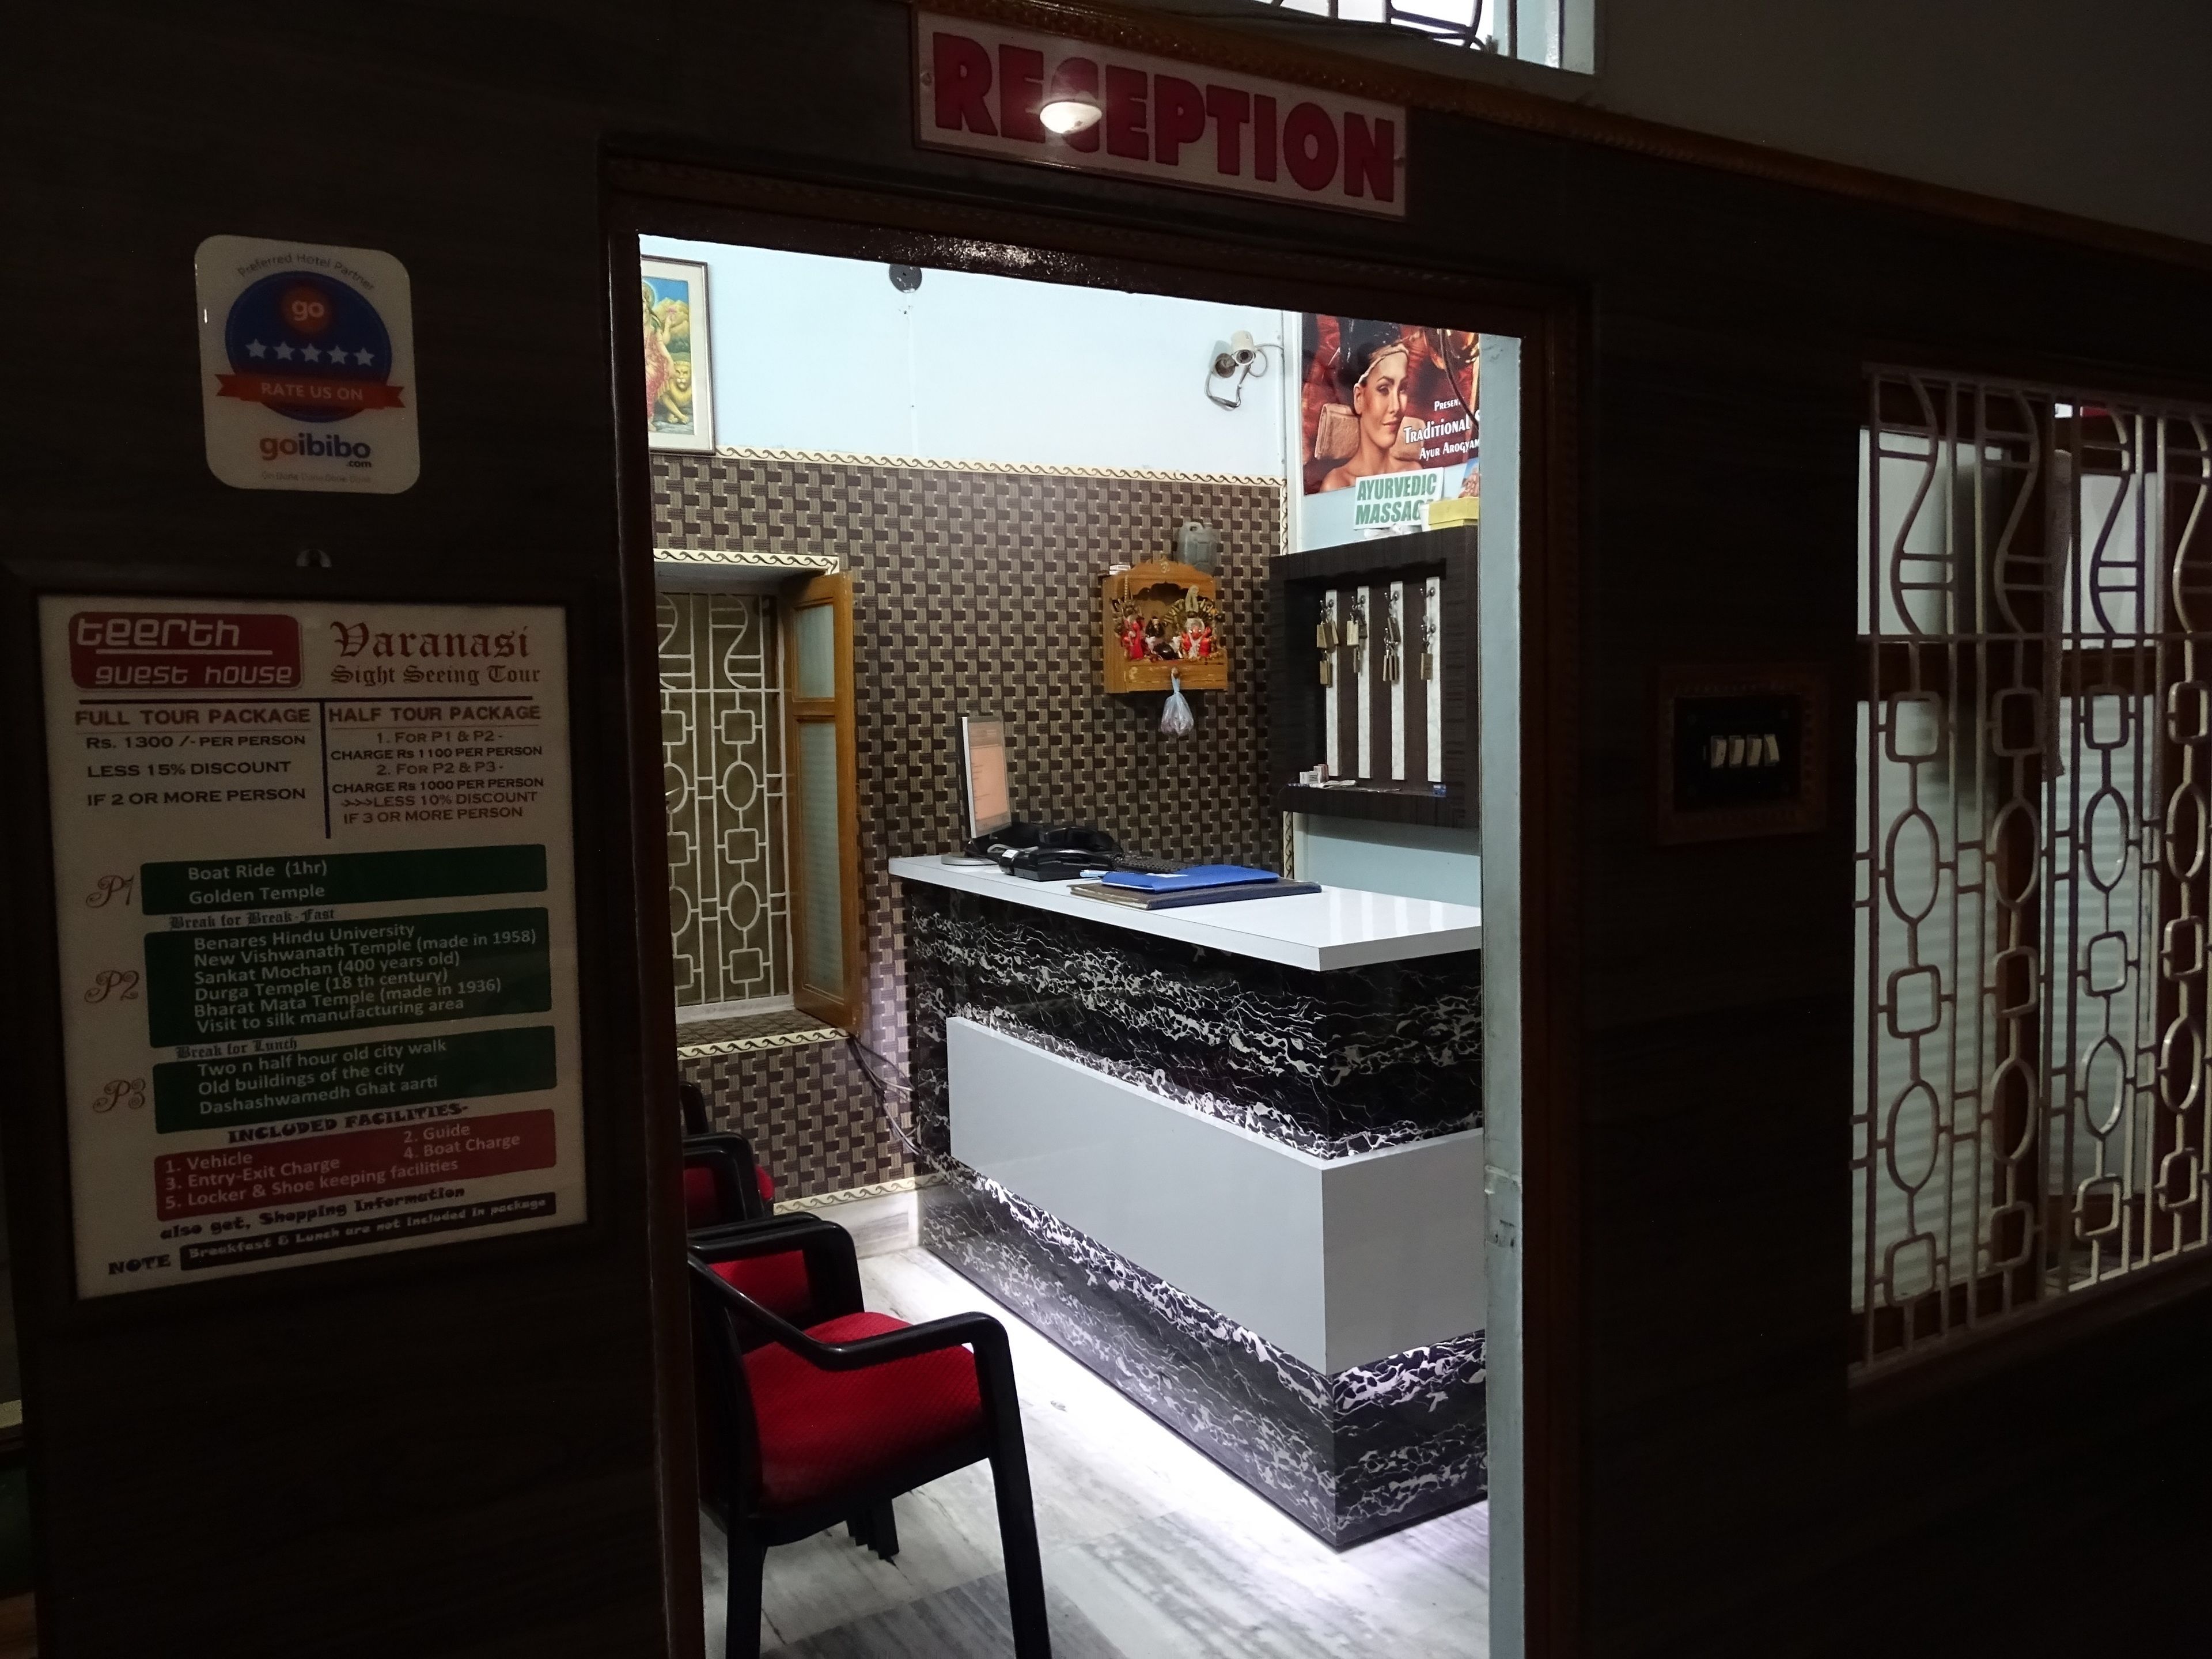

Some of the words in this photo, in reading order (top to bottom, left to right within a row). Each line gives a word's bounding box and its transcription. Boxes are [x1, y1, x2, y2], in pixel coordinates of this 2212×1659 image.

[932, 32, 1395, 203] RECEPTION
[237, 254, 293, 278] Preferred
[297, 253, 331, 269] Hotel
[334, 262, 375, 291] Partner
[291, 300, 325, 321] go
[261, 382, 305, 398] RATE
[310, 385, 332, 399] US
[336, 388, 363, 401] ON
[259, 433, 372, 460] goibibo
[1419, 446, 1440, 461] AYUR
[346, 460, 372, 468] .com
[1357, 473, 1437, 502] AYURVEDIC
[1355, 499, 1434, 525] MASSAG
[76, 618, 240, 647] teerth
[329, 621, 529, 658] Varanasi
[94, 665, 189, 685] guest
[204, 665, 292, 685] house
[330, 665, 396, 687] Sight
[403, 665, 480, 686] Seeing
[486, 665, 541, 683] Tour
[75, 711, 130, 726] FULL
[139, 710, 199, 725] TOUR
[209, 709, 311, 724] PACKAGE
[329, 708, 381, 722] HALF
[390, 707, 442, 721] TOUR
[449, 705, 541, 720] PACKAGE
[125, 736, 173, 748] 1300
[237, 735, 306, 746] PERSON
[431, 731, 451, 742] P1
[457, 730, 469, 742] &
[330, 749, 393, 761] CHARGE
[419, 748, 453, 759] 1100
[456, 747, 484, 757] PER
[486, 745, 543, 756] PERSON
[88, 764, 141, 778] LESS
[148, 763, 185, 776] 15%
[191, 761, 291, 775] DISCOUNT
[376, 765, 391, 775] 2.
[432, 762, 455, 774] P2
[460, 762, 471, 773] &
[88, 794, 107, 806] IF
[111, 793, 124, 805] 2
[128, 792, 159, 805] OR
[163, 790, 222, 804] MORE
[226, 788, 306, 801] PERSON
[332, 782, 395, 794] CHARGE
[420, 781, 454, 791] 1000
[457, 779, 485, 790] PER
[487, 778, 544, 789] PERSON
[421, 794, 453, 806] 10%
[456, 791, 539, 804] DISCOUNT
[344, 813, 361, 824] IF
[362, 813, 374, 824] 3
[377, 811, 401, 823] OR
[404, 809, 453, 821] MORE
[457, 806, 523, 820] PERSON
[188, 865, 231, 881] Boat
[235, 863, 276, 878] Ride
[284, 859, 328, 878] (1hr)
[85, 874, 135, 908] P1
[188, 889, 255, 905] Golden
[258, 884, 326, 902] Temple
[169, 915, 217, 930] Break
[221, 914, 242, 927] for
[194, 934, 268, 951] Benares
[272, 929, 325, 946] Hindu
[329, 924, 416, 941] University
[194, 952, 236, 968] New
[240, 943, 346, 964] Vishwanath
[349, 938, 412, 956] Temple
[416, 936, 469, 953] (made
[473, 934, 488, 946] in
[492, 928, 537, 945] 1958)
[194, 969, 256, 986] Sankat
[260, 963, 333, 980] Mochan
[338, 957, 376, 975] (400
[378, 954, 424, 972] years
[427, 950, 461, 968] old)
[84, 969, 139, 1003] P2
[194, 986, 249, 1003] Durga
[253, 979, 320, 998] Temple
[325, 976, 353, 994] (18
[356, 974, 374, 987] th
[379, 968, 449, 986] century)
[194, 1002, 257, 1018] Bharat
[260, 997, 307, 1012] Mata
[313, 989, 376, 1007] Temple
[380, 985, 432, 1003] (made
[437, 983, 452, 996] in
[457, 977, 502, 995] 1936)
[197, 1017, 237, 1034] Visit
[241, 1017, 261, 1029] to
[266, 1013, 296, 1027] silk
[300, 1002, 425, 1024] manufacturing
[427, 999, 464, 1012] area
[176, 1044, 221, 1059] Break
[226, 1043, 249, 1055] for
[252, 1037, 298, 1052] Lunch
[197, 1063, 237, 1078] Two
[242, 1062, 253, 1073] n
[258, 1055, 292, 1071] half
[297, 1052, 337, 1067] hour
[342, 1046, 370, 1062] old
[373, 1045, 404, 1061] city
[408, 1039, 448, 1055] walk
[198, 1080, 230, 1096] Old
[234, 1071, 316, 1092] buildings
[320, 1069, 338, 1082] of
[342, 1064, 370, 1079] the
[374, 1062, 404, 1079] city
[199, 1086, 351, 1116] Dashashwamedh
[355, 1081, 397, 1097] Ghat
[400, 1074, 439, 1092] aarti
[228, 1116, 338, 1143] INCLUDED
[403, 1130, 419, 1144] 2.
[422, 1123, 471, 1141] Guide
[403, 1146, 419, 1160] 4.
[423, 1142, 461, 1157] Boat
[465, 1134, 521, 1152] Charge
[165, 1159, 181, 1173] 1.
[186, 1152, 253, 1171] Vehicle
[165, 1176, 182, 1191] 3.
[187, 1166, 276, 1188] Entry-Exit
[280, 1157, 341, 1178] Charge
[165, 1195, 182, 1210] 5.
[187, 1187, 248, 1206] Locker
[251, 1184, 267, 1198] &
[271, 1180, 315, 1196] Shoe
[319, 1168, 387, 1189] keeping
[389, 1158, 459, 1179] facilities
[160, 1225, 202, 1240] also
[210, 1218, 252, 1235] get,
[259, 1200, 348, 1225] Shopping
[354, 1187, 465, 1213] Information
[188, 1238, 272, 1259] Breakfast
[277, 1235, 290, 1247] &
[294, 1228, 340, 1244] Lunch
[346, 1224, 371, 1236] are
[376, 1218, 401, 1233] not
[490, 1198, 547, 1215] package
[108, 1254, 171, 1275] NOTE
